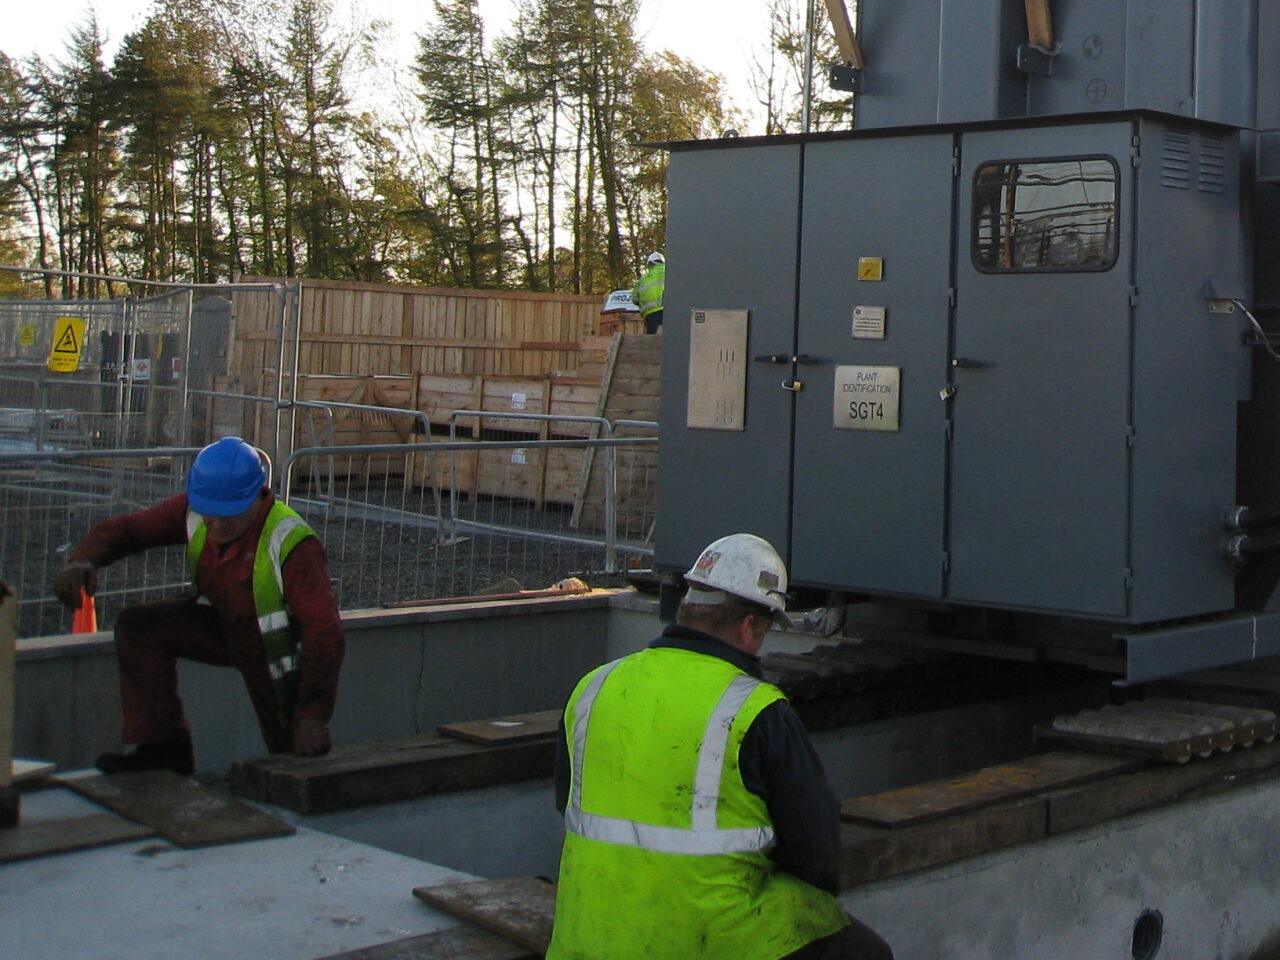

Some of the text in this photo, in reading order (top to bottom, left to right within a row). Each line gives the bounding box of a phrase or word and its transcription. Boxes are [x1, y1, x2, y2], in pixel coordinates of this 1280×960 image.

[857, 372, 878, 381] PLANT
[843, 383, 891, 394] IDENTIFICATION
[849, 401, 884, 420] SGT4
